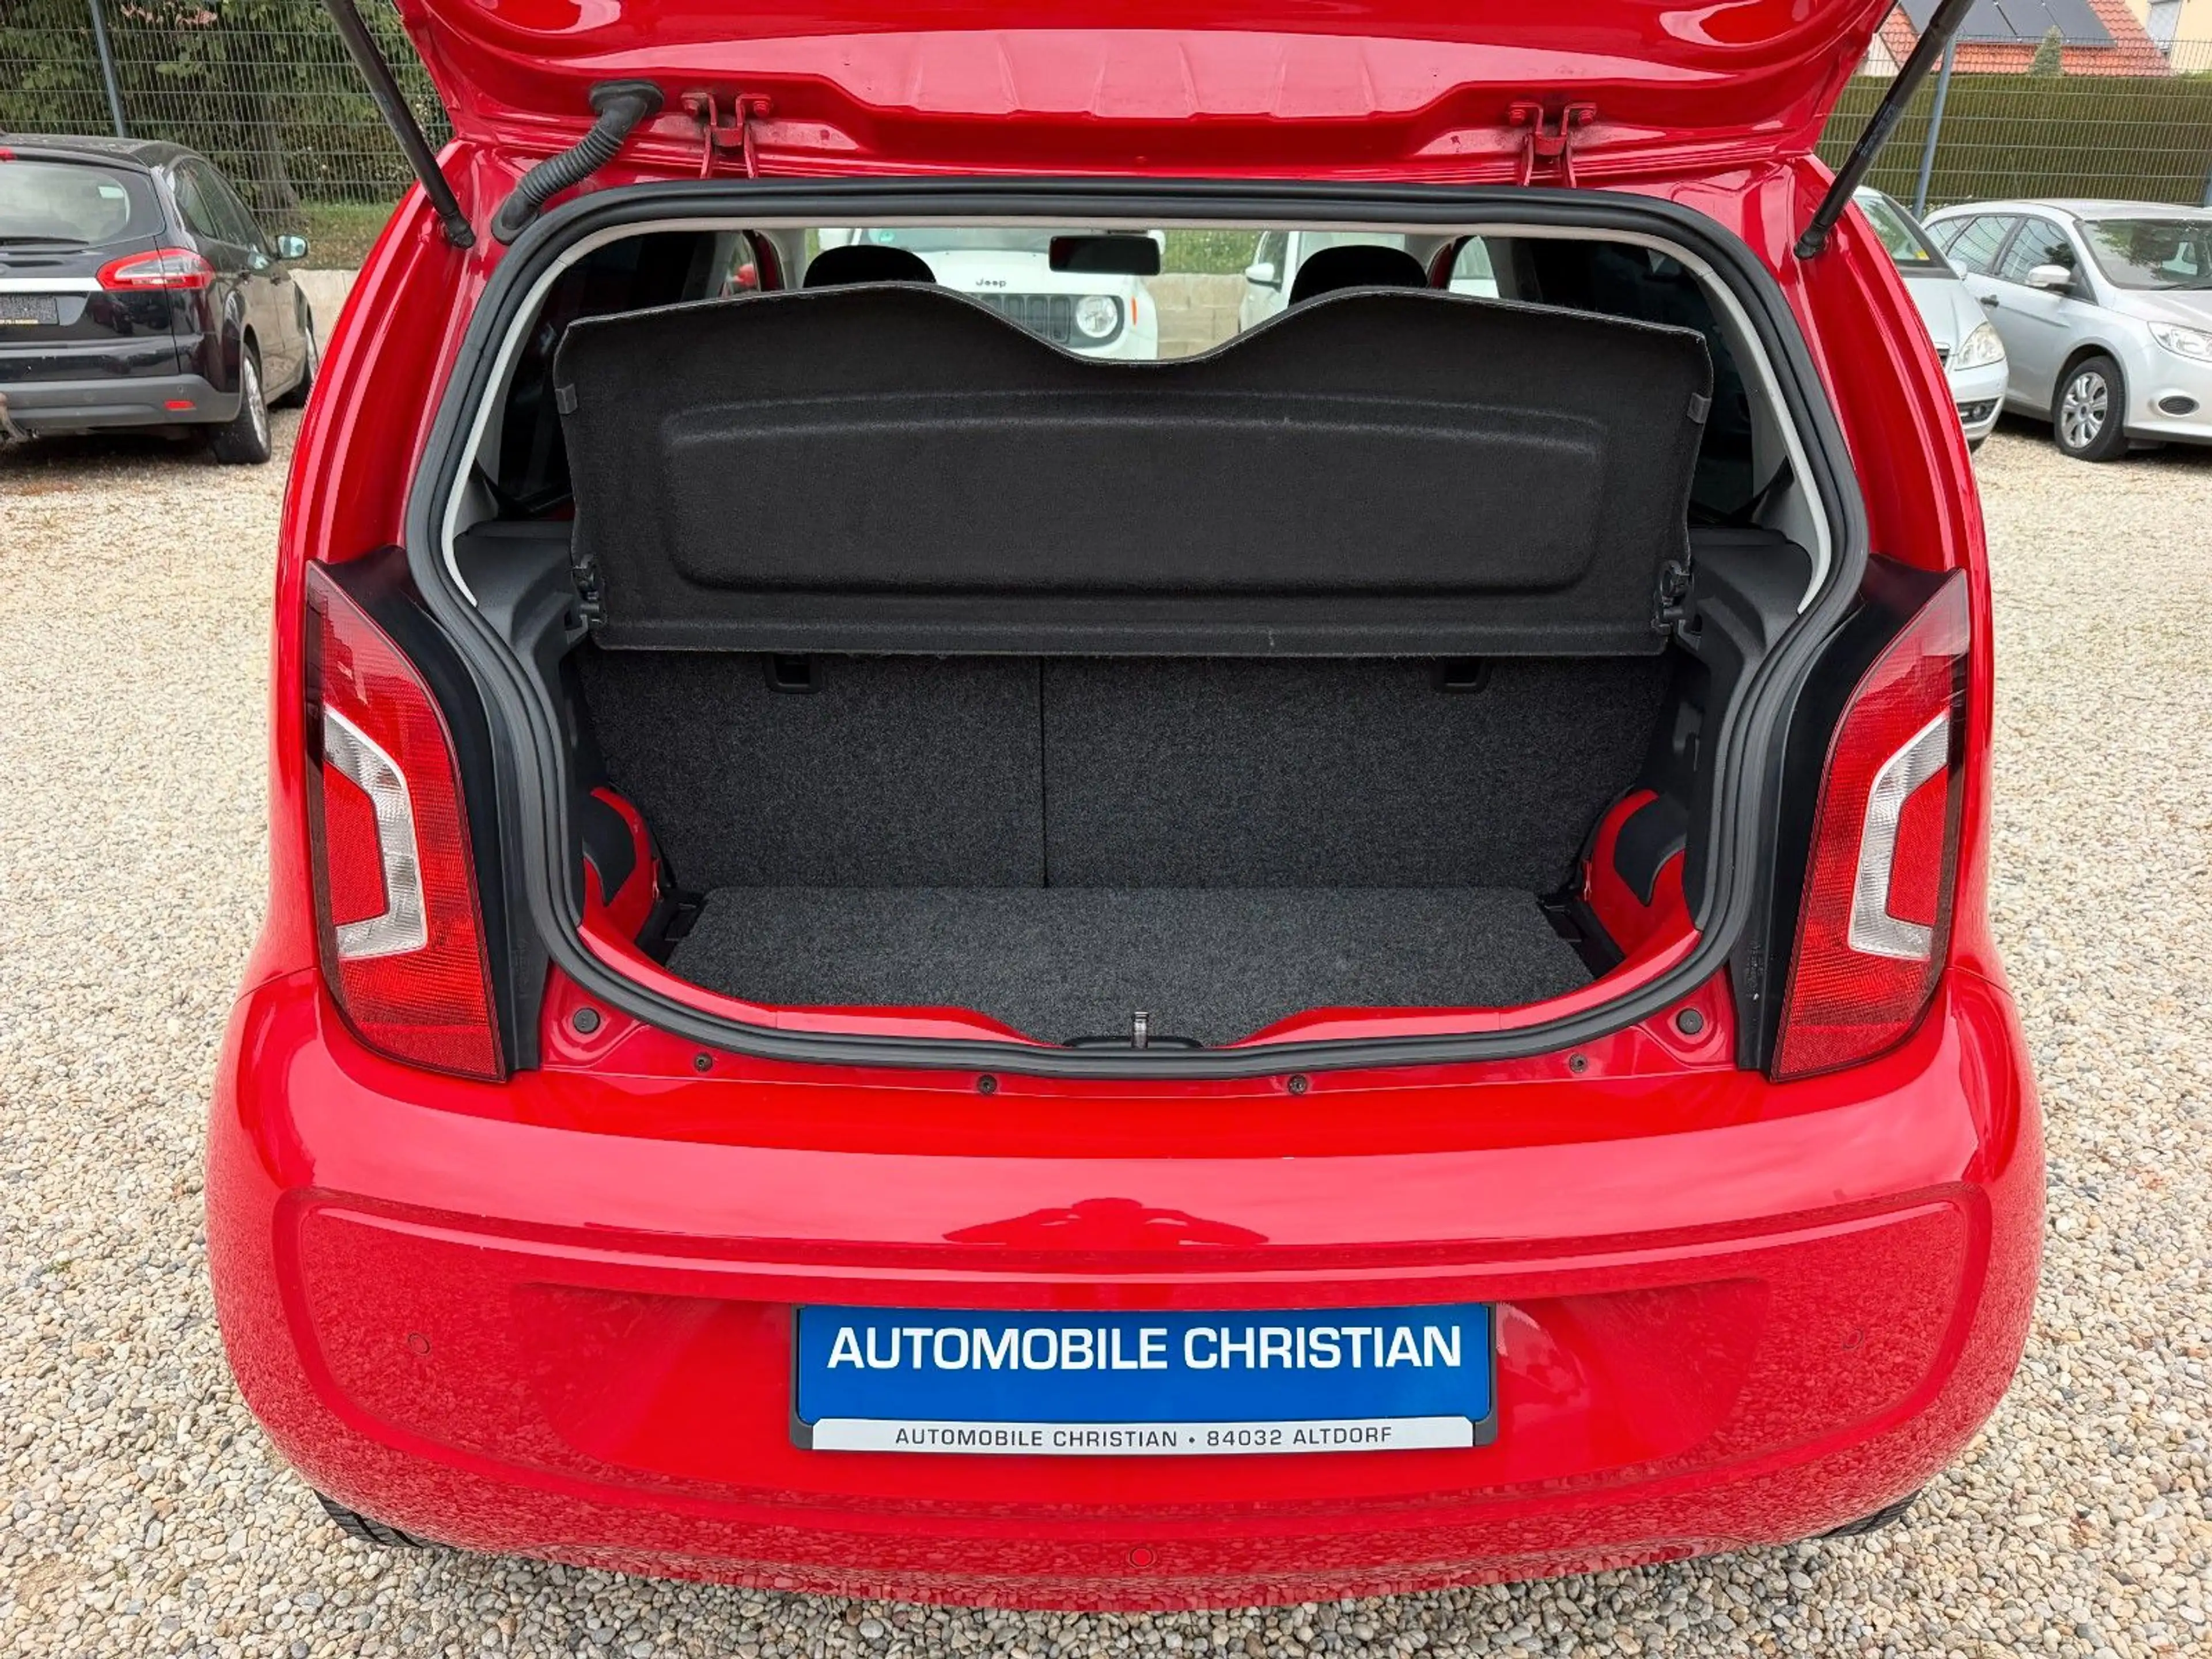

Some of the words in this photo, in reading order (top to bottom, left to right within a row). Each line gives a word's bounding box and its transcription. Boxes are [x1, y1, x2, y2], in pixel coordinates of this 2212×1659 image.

[975, 276, 1007, 289] Jeep
[827, 1327, 1168, 1370] AUTOMOBILE
[1184, 1325, 1461, 1369] CHRISTIAN
[895, 1427, 1043, 1446] AUTOMOBILE
[1053, 1430, 1177, 1447] CHRISTIAN
[1206, 1429, 1282, 1446] 84032
[1292, 1426, 1392, 1444] ALTDORF
